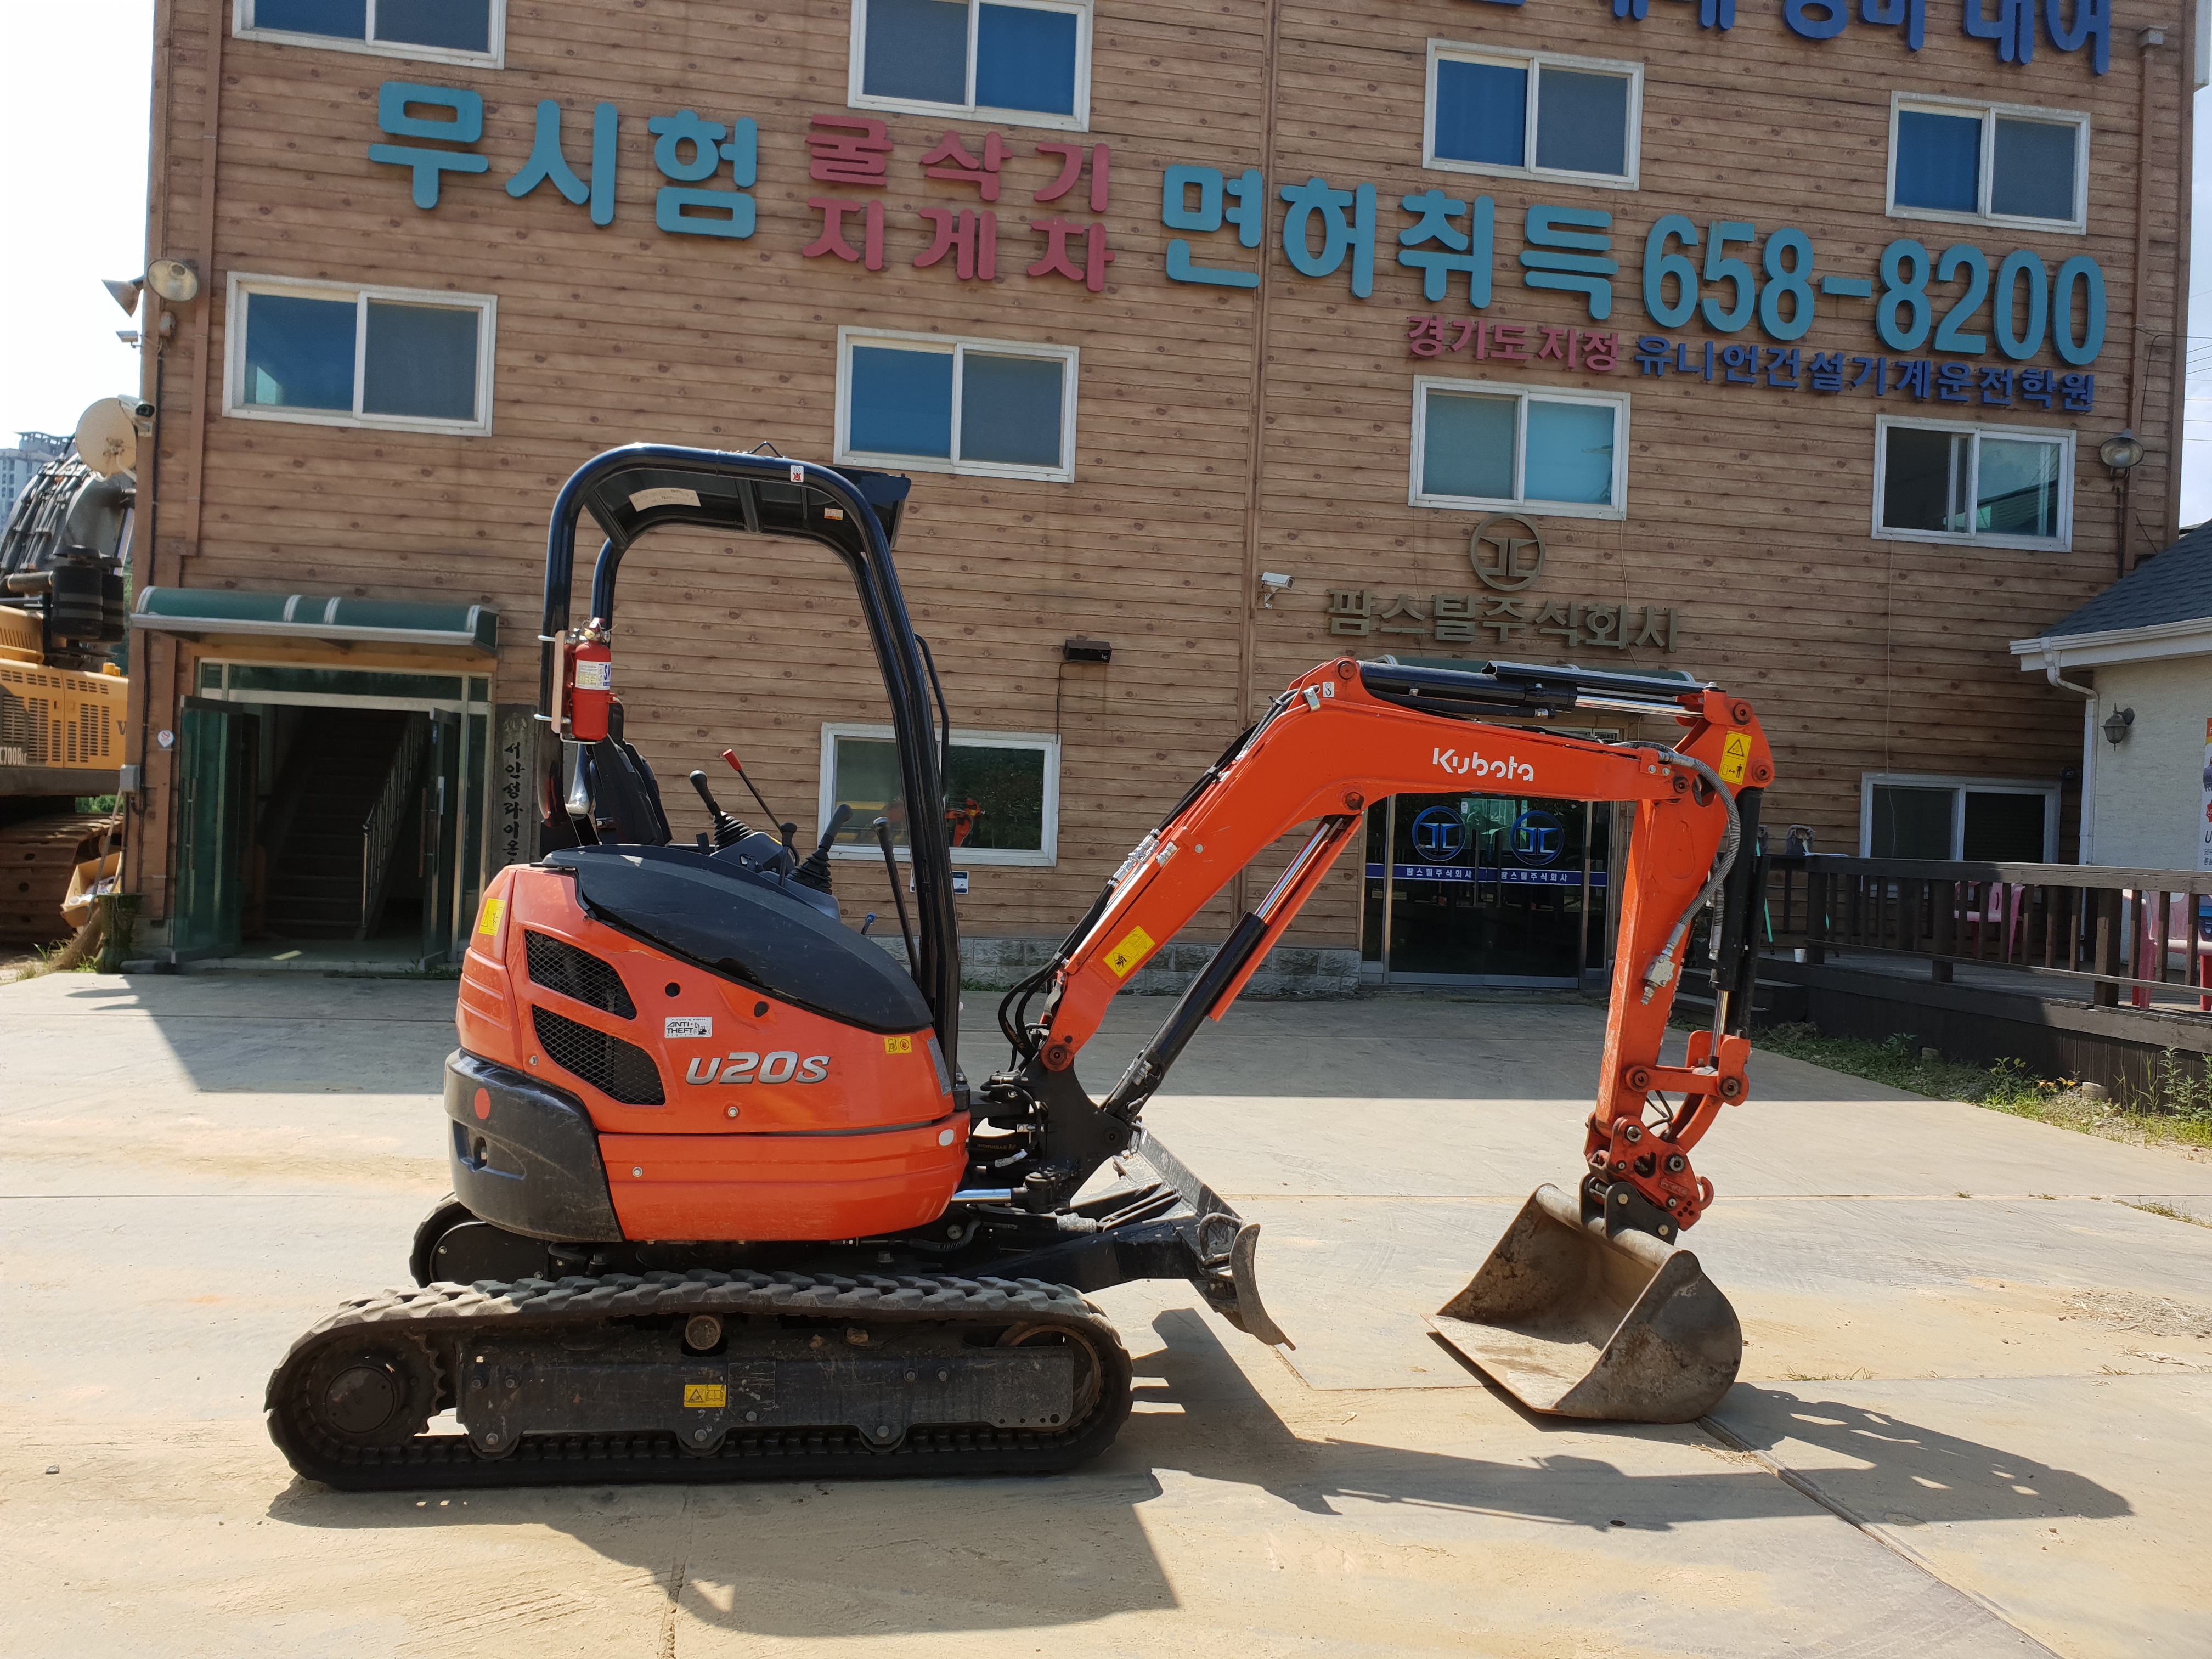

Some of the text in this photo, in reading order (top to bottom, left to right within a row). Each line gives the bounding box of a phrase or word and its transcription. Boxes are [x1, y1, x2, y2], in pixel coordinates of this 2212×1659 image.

[368, 81, 757, 239] 무시험
[806, 114, 1110, 212] 굴삭기
[803, 197, 1116, 292] 지게차
[1162, 164, 2106, 365] 면허취득 658-8200
[503, 742, 526, 865] 서안성라이온
[1432, 747, 1534, 782] Kubota
